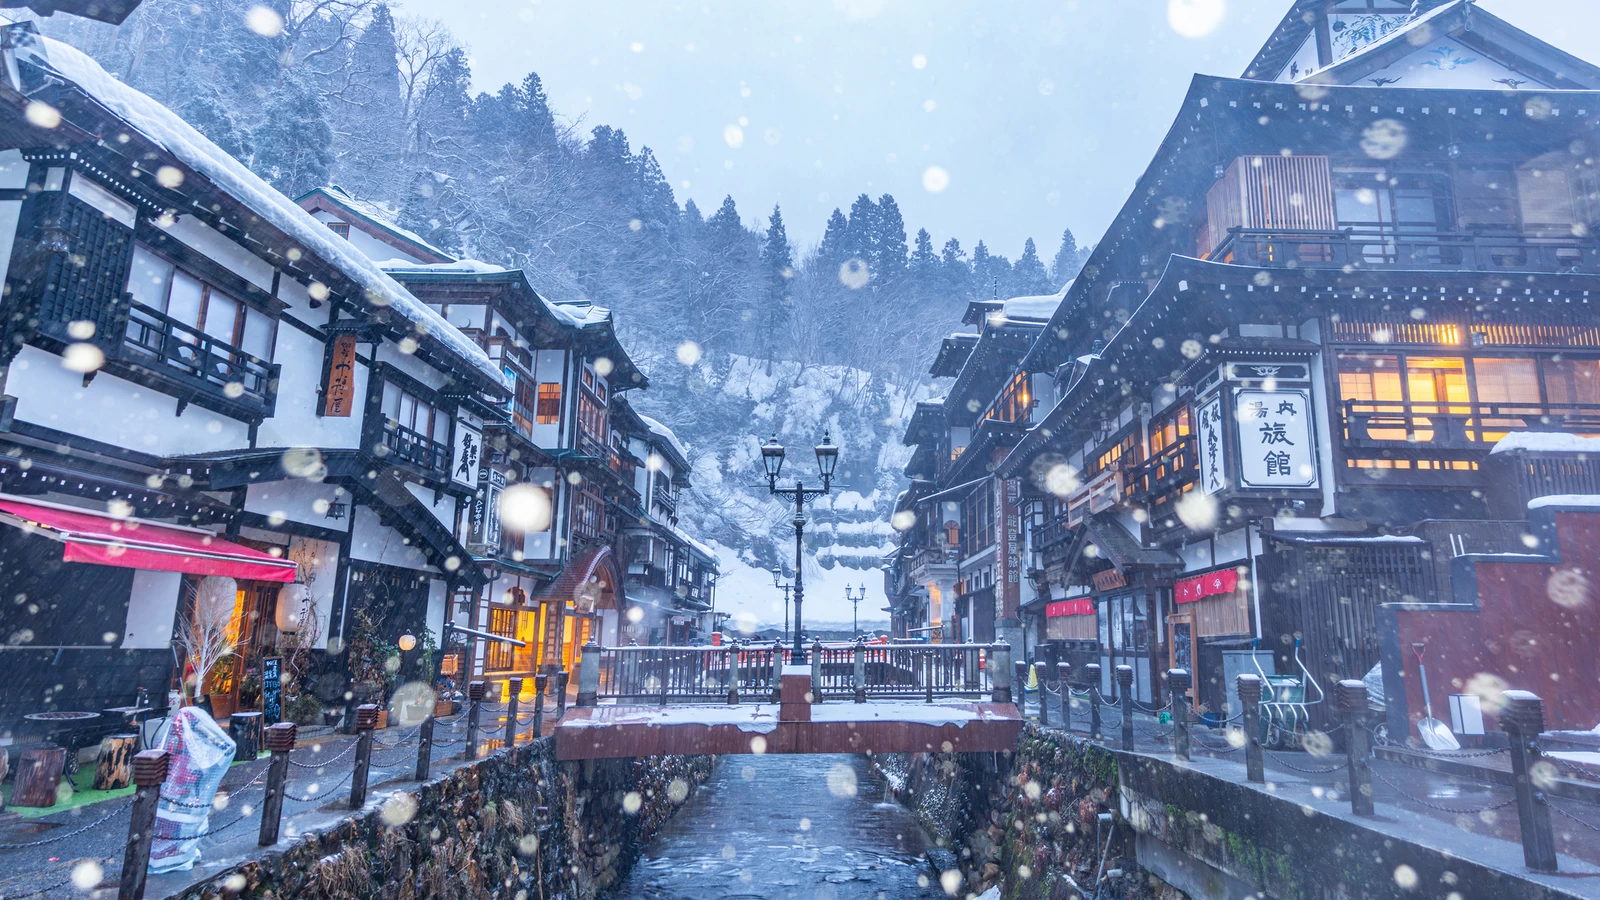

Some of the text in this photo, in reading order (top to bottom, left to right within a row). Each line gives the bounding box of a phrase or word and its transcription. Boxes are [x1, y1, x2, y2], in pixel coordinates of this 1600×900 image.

[1259, 422, 1295, 477] 旅館
[1007, 515, 1019, 583] 能登屋旅館
